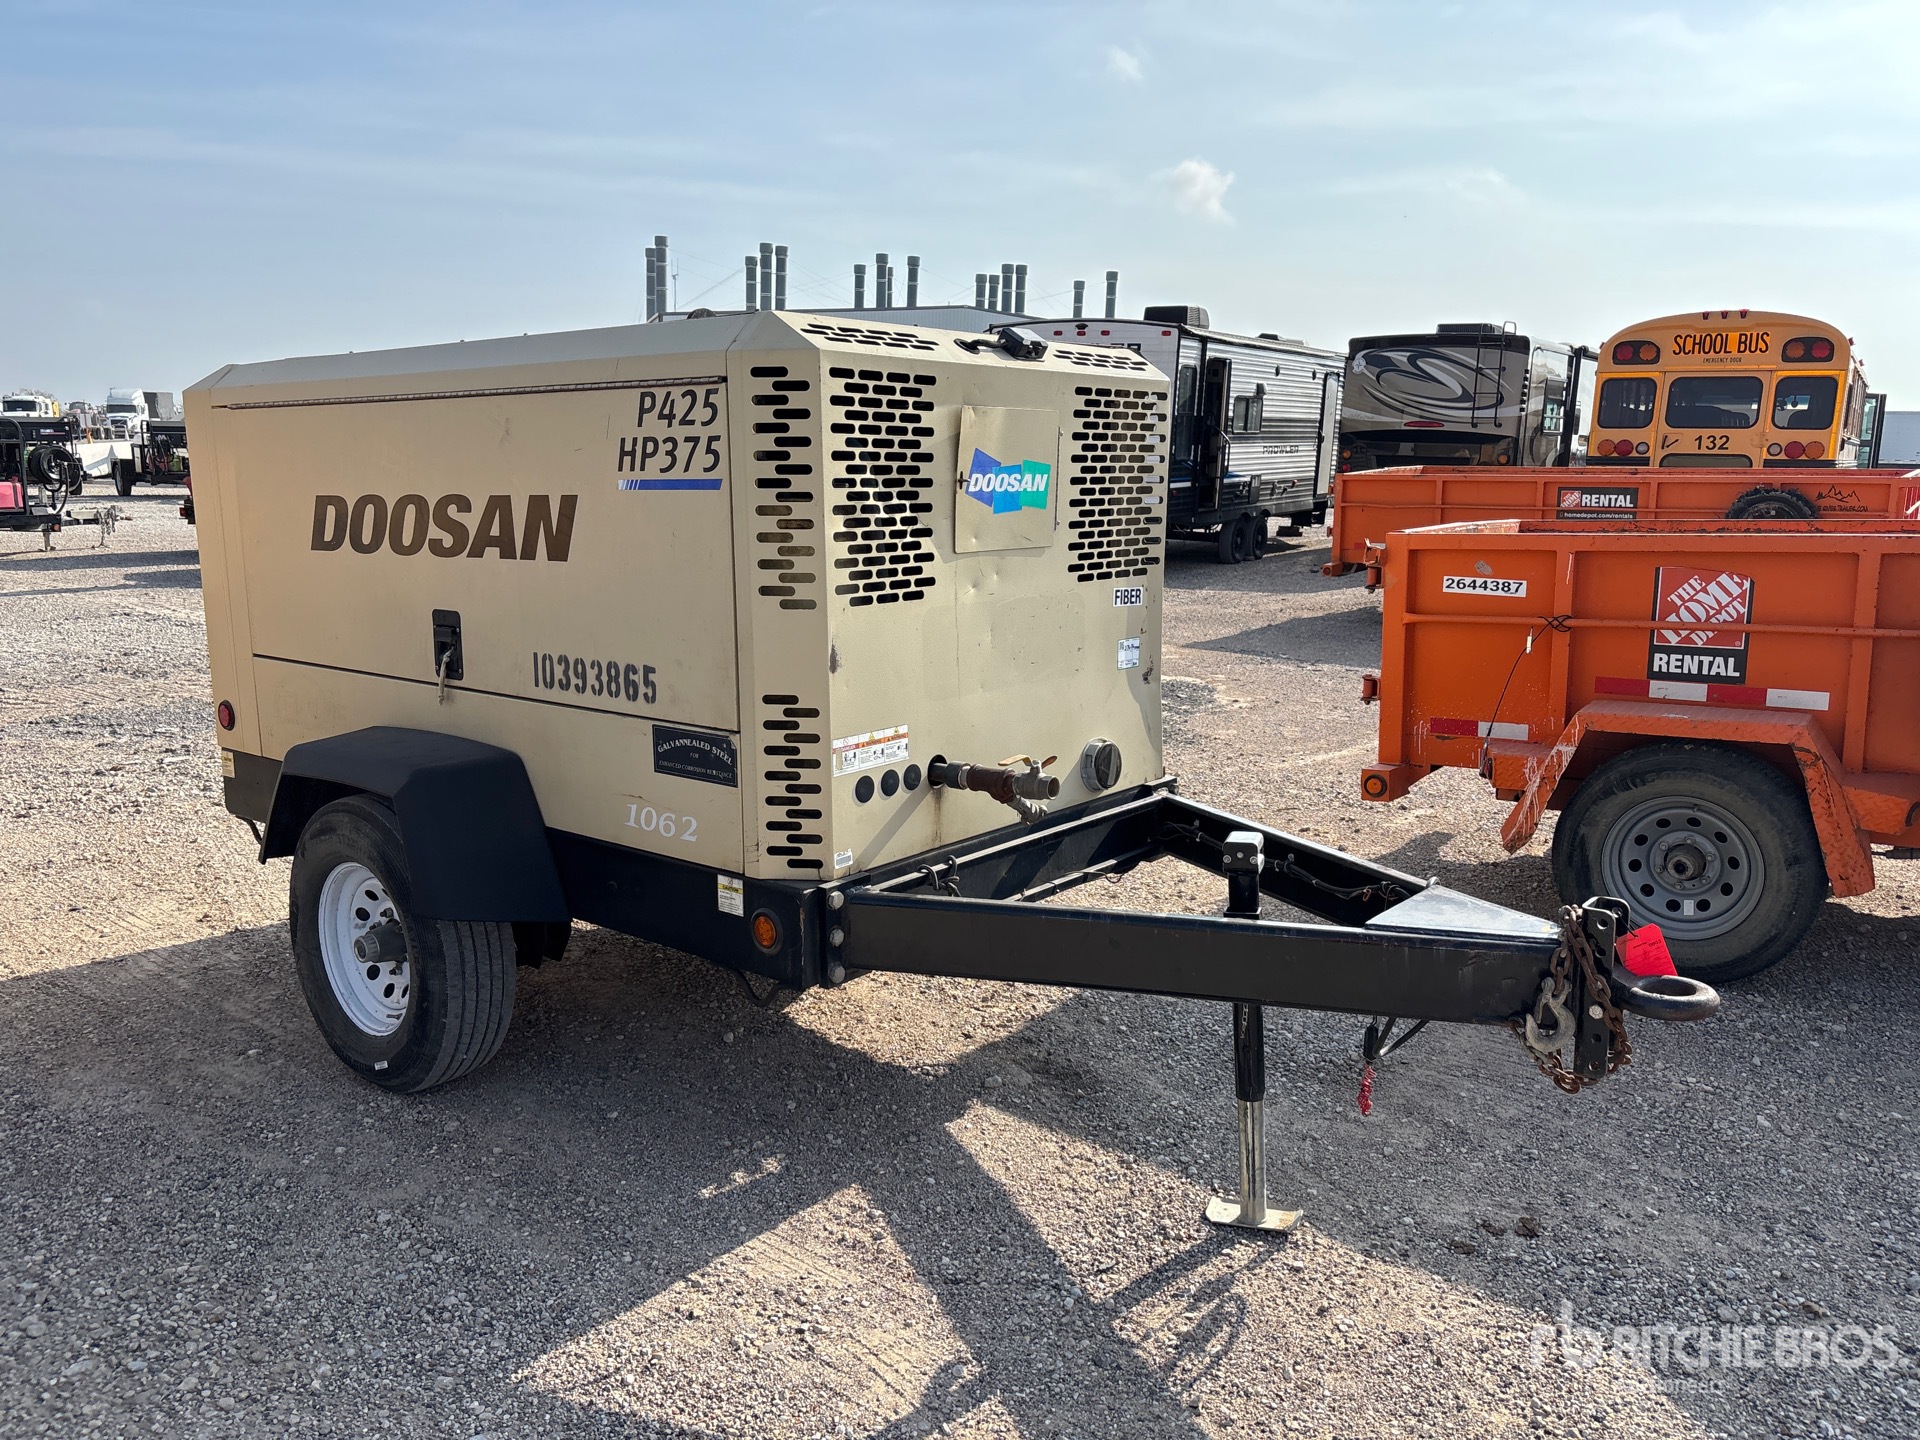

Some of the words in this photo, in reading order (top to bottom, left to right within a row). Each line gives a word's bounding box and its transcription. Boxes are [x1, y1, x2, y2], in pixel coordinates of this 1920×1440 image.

[1672, 333, 1732, 356] SCHOOL
[1737, 331, 1770, 353] BUS
[637, 387, 719, 428] P425
[617, 435, 721, 474] HP375
[1694, 434, 1730, 451] 132
[968, 473, 1048, 492] DOOSAN
[1581, 494, 1634, 508] RENTAL
[311, 494, 578, 562] DOOSAN
[1114, 588, 1142, 605] FIBER
[1445, 577, 1524, 594] 2644387
[1667, 575, 1706, 606] THE
[1660, 571, 1750, 645] HOME
[533, 652, 657, 704] 10393865
[1653, 653, 1740, 677] RENTAL
[657, 738, 711, 753] GALVANNEALED
[711, 746, 733, 766] STEEL
[623, 803, 698, 842] 1062
